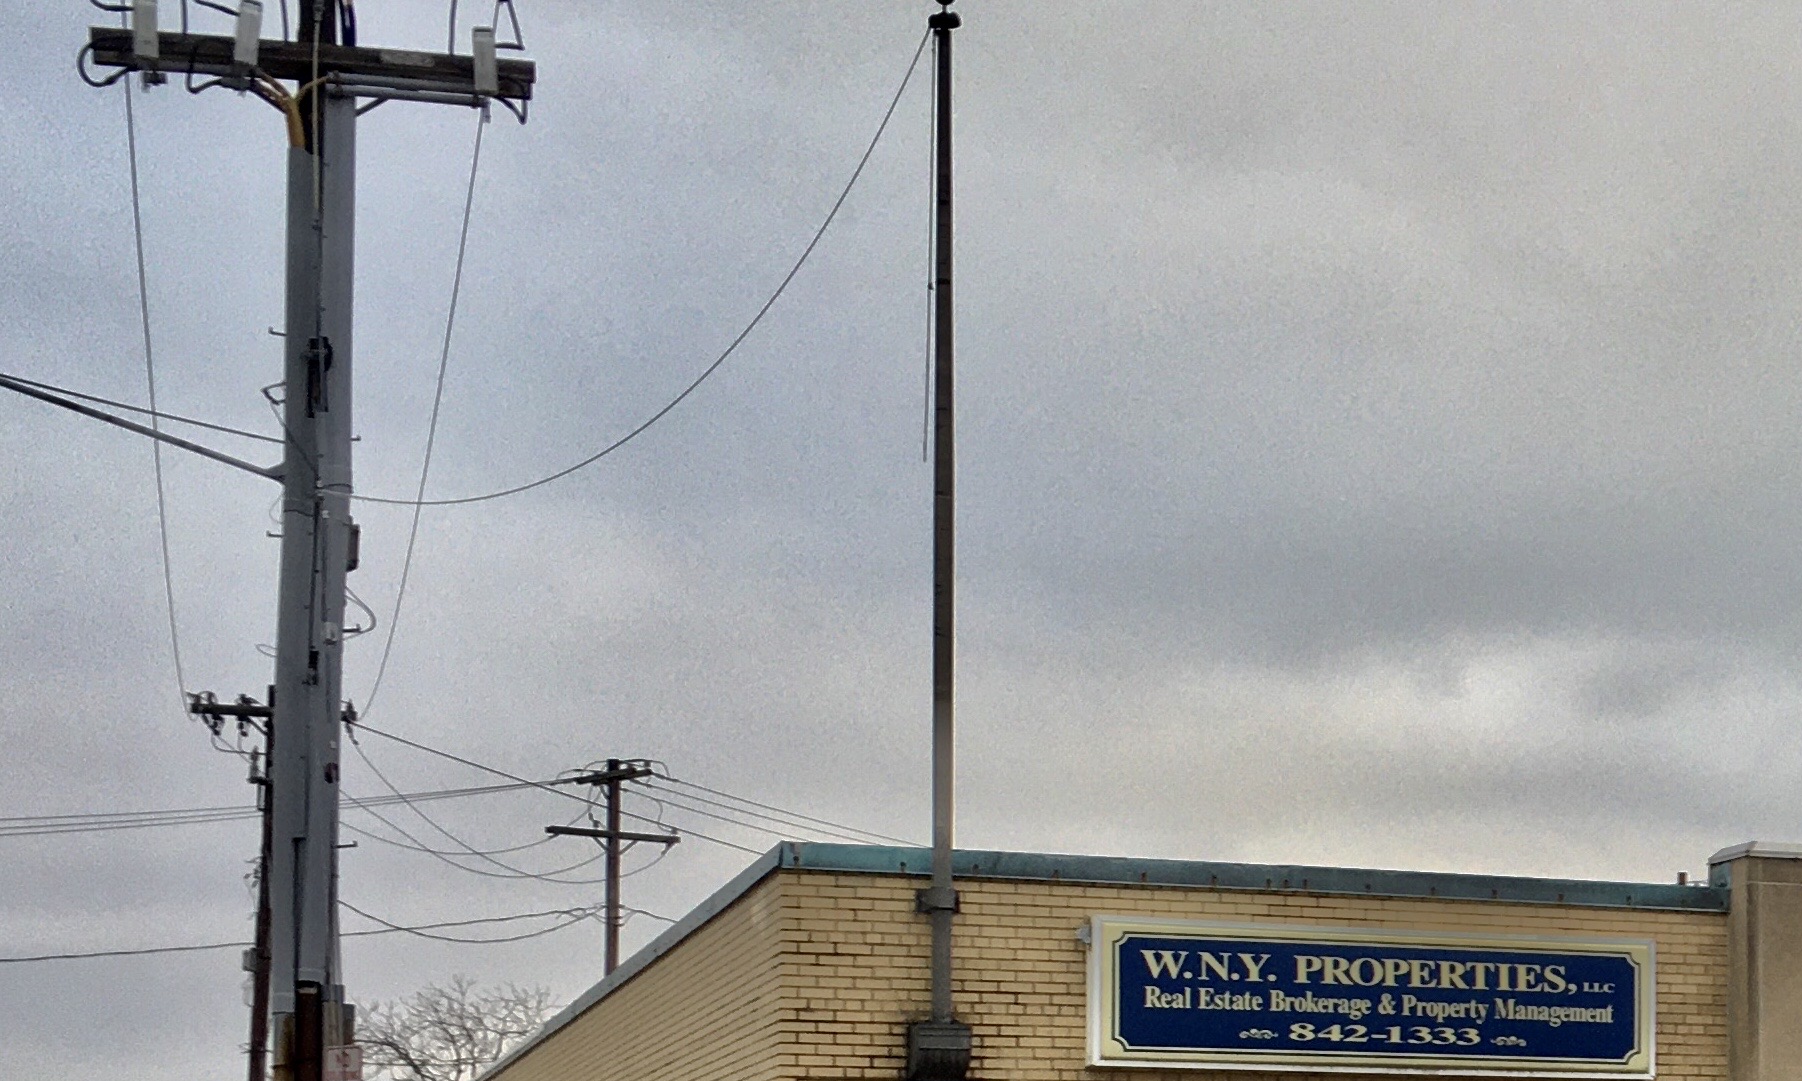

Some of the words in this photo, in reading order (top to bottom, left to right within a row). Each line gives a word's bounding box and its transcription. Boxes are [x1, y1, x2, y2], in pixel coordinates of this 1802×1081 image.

[1140, 949, 1277, 982] W.N.Y.
[1293, 955, 1577, 995] PROPERTIES,
[1582, 982, 1616, 994] LLC
[1144, 985, 1192, 1010] Real
[1198, 987, 1264, 1011] Estate
[1269, 989, 1372, 1020] Brokerage
[1377, 993, 1397, 1016] &
[1401, 994, 1489, 1025] Property
[1494, 998, 1614, 1028] Management
[1288, 1022, 1482, 1045] 842-1333
